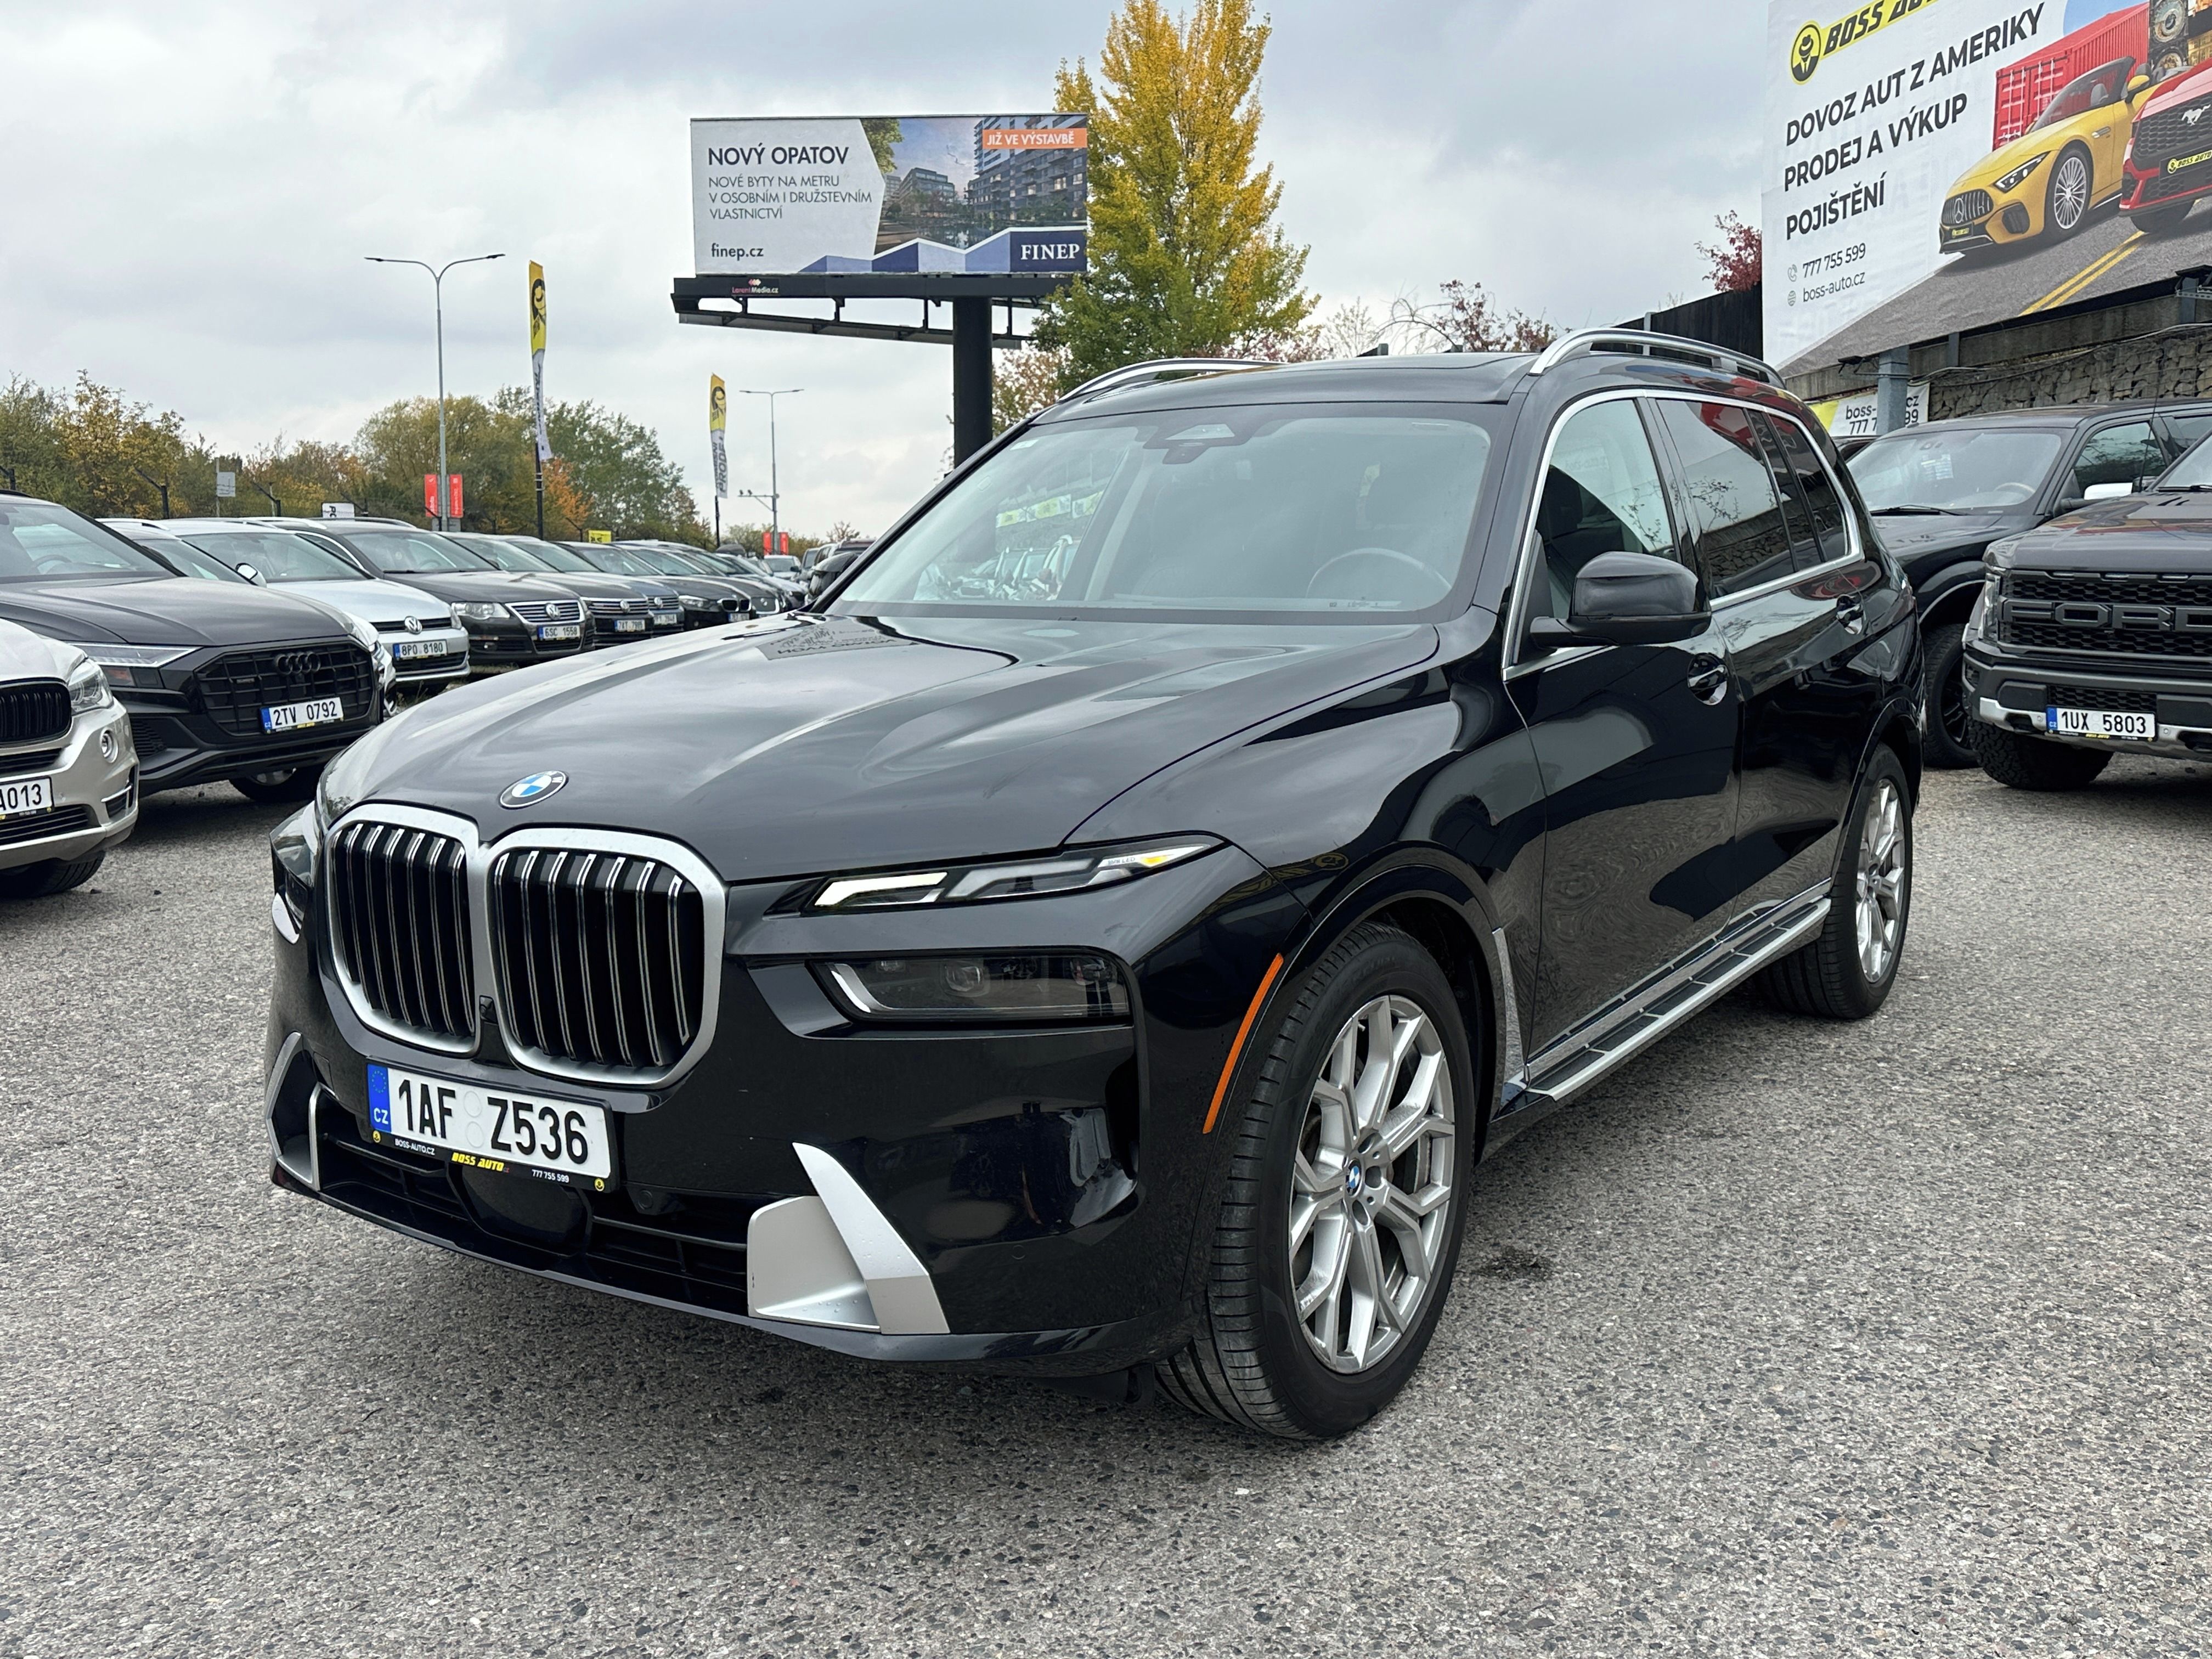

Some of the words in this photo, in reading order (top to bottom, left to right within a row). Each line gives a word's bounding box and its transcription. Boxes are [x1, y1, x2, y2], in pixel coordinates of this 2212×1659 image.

[1824, 0, 1884, 56] BOSS
[1786, 91, 1857, 146] DOVOZ
[1860, 69, 1906, 113] AUT
[1910, 60, 1925, 91] Z
[1928, 2, 2045, 82] AMERIKY
[987, 132, 1002, 145] JIŽ
[1005, 134, 1019, 145] VE
[1020, 131, 1075, 145] VÝSTAVBĚ
[1785, 136, 1862, 192] PRODEJ
[1867, 129, 1883, 158] A
[1888, 93, 1967, 148] VÝKUP
[708, 142, 765, 165] NOVÝ
[771, 146, 849, 165] OPATOV
[708, 173, 744, 188] NOVÉ
[747, 176, 775, 188] BYTY
[778, 176, 797, 187] NA
[800, 175, 839, 187] METRU
[709, 193, 718, 204] V
[720, 189, 780, 204] OSOBNÍM
[783, 191, 786, 203] I
[789, 188, 872, 203] DRUŽSTEVNÍM
[709, 205, 783, 219] VLASTNICTVÍ
[1786, 171, 1887, 241] POJIŠTĚNÍ
[711, 242, 764, 261] finep.cz
[1020, 244, 1080, 261] FINEP
[1802, 257, 1822, 278] 777
[1824, 250, 1843, 272] 755
[1844, 242, 1866, 264] 599
[1803, 272, 1866, 302] boss-auto.cz
[1849, 419, 1869, 435] 777
[423, 642, 443, 654] 8180
[273, 706, 297, 726] 2TV
[306, 701, 337, 720] 0792
[2062, 711, 2090, 731] 1UX
[2102, 714, 2146, 734] 5803
[374, 1108, 389, 1125] CZ
[398, 1079, 456, 1139] 1AF
[487, 1096, 589, 1165] Z536
[394, 1138, 436, 1156] BOSS-AUTO.CZ
[452, 1152, 476, 1166] BOSS
[477, 1158, 505, 1172] AUTO
[531, 1169, 543, 1178] 777
[544, 1171, 556, 1181] 755
